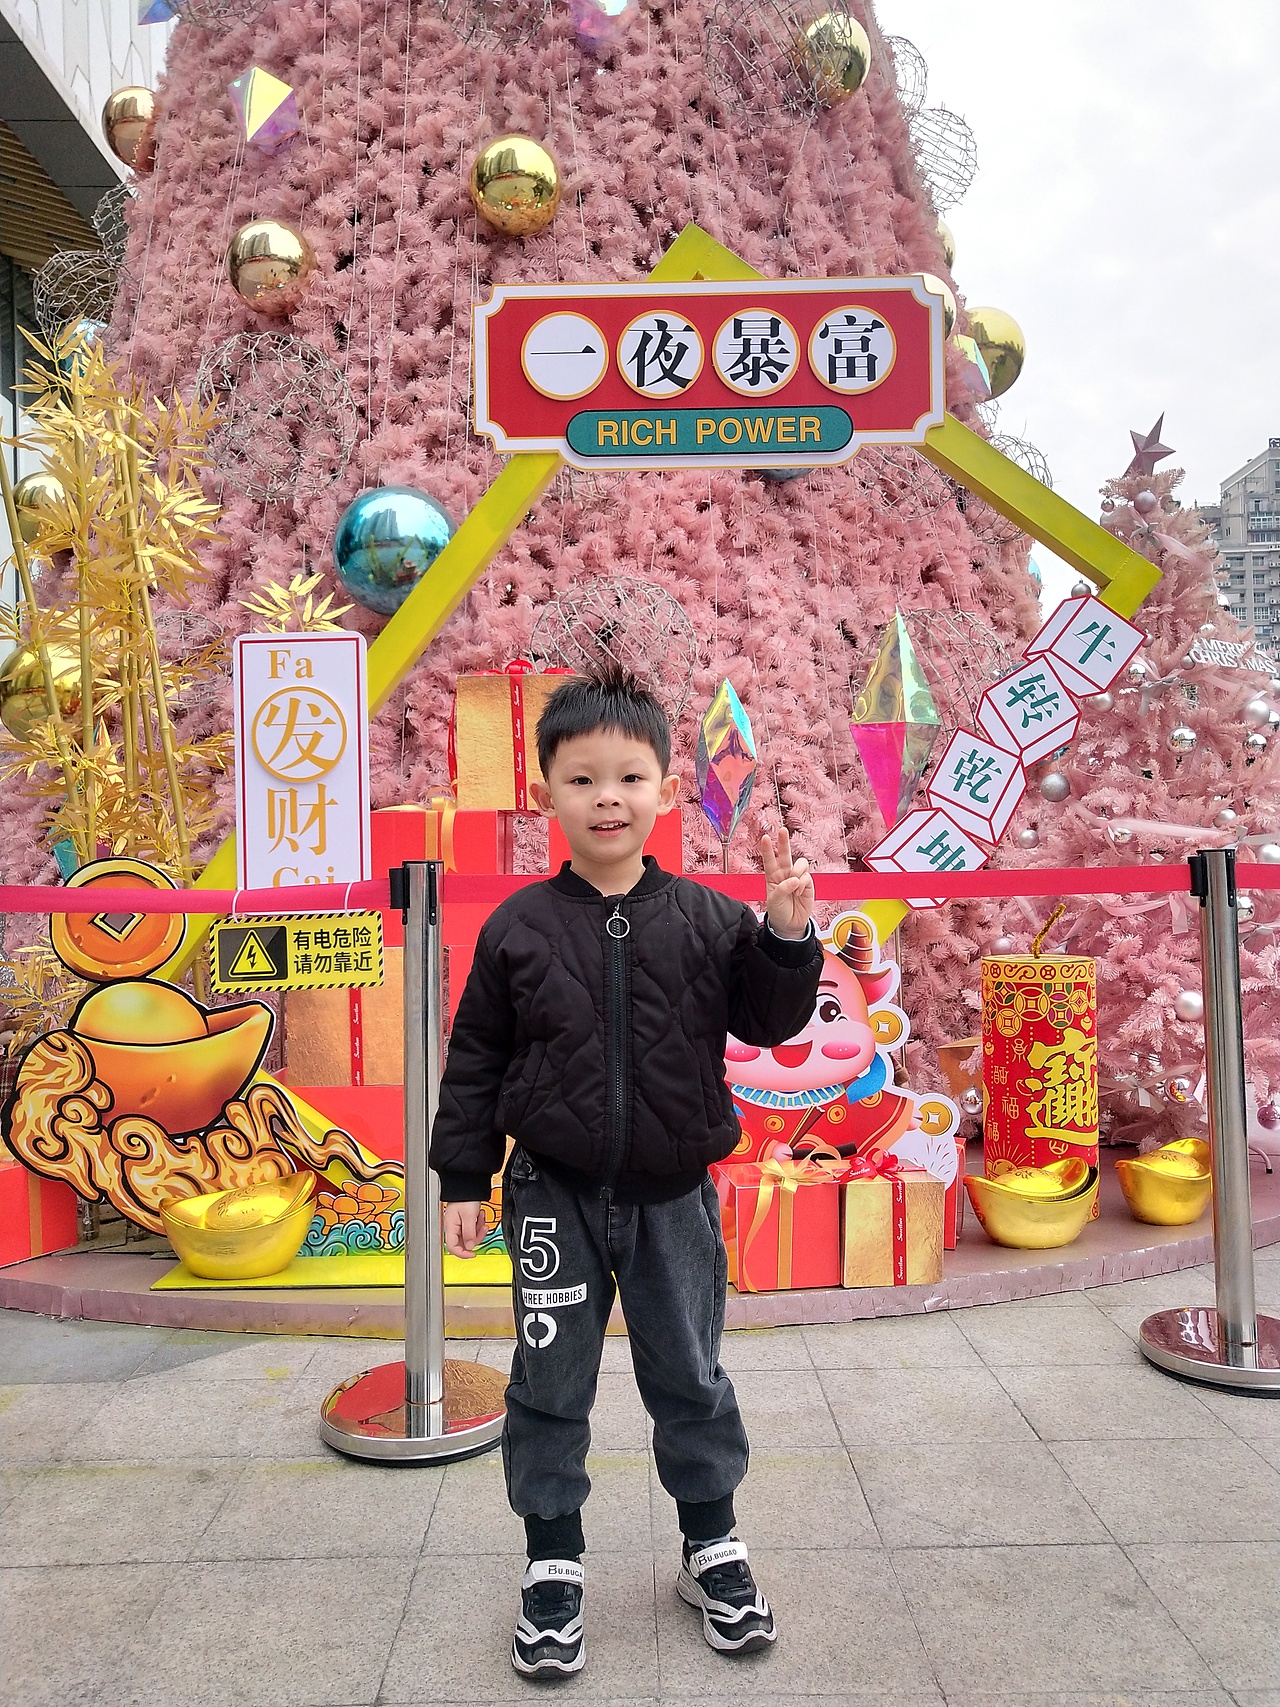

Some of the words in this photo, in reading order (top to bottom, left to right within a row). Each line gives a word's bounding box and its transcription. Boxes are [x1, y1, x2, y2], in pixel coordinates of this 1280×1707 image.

[530, 315, 886, 389] 一夜暴富
[597, 419, 676, 446] RICH
[696, 416, 822, 445] POWER
[267, 649, 314, 679] Fa
[262, 697, 338, 856] 发财
[293, 927, 372, 951] 有电危险
[293, 950, 373, 974] 请勿靠近
[520, 1216, 560, 1281] 5
[546, 1289, 583, 1304] HOBBIES
